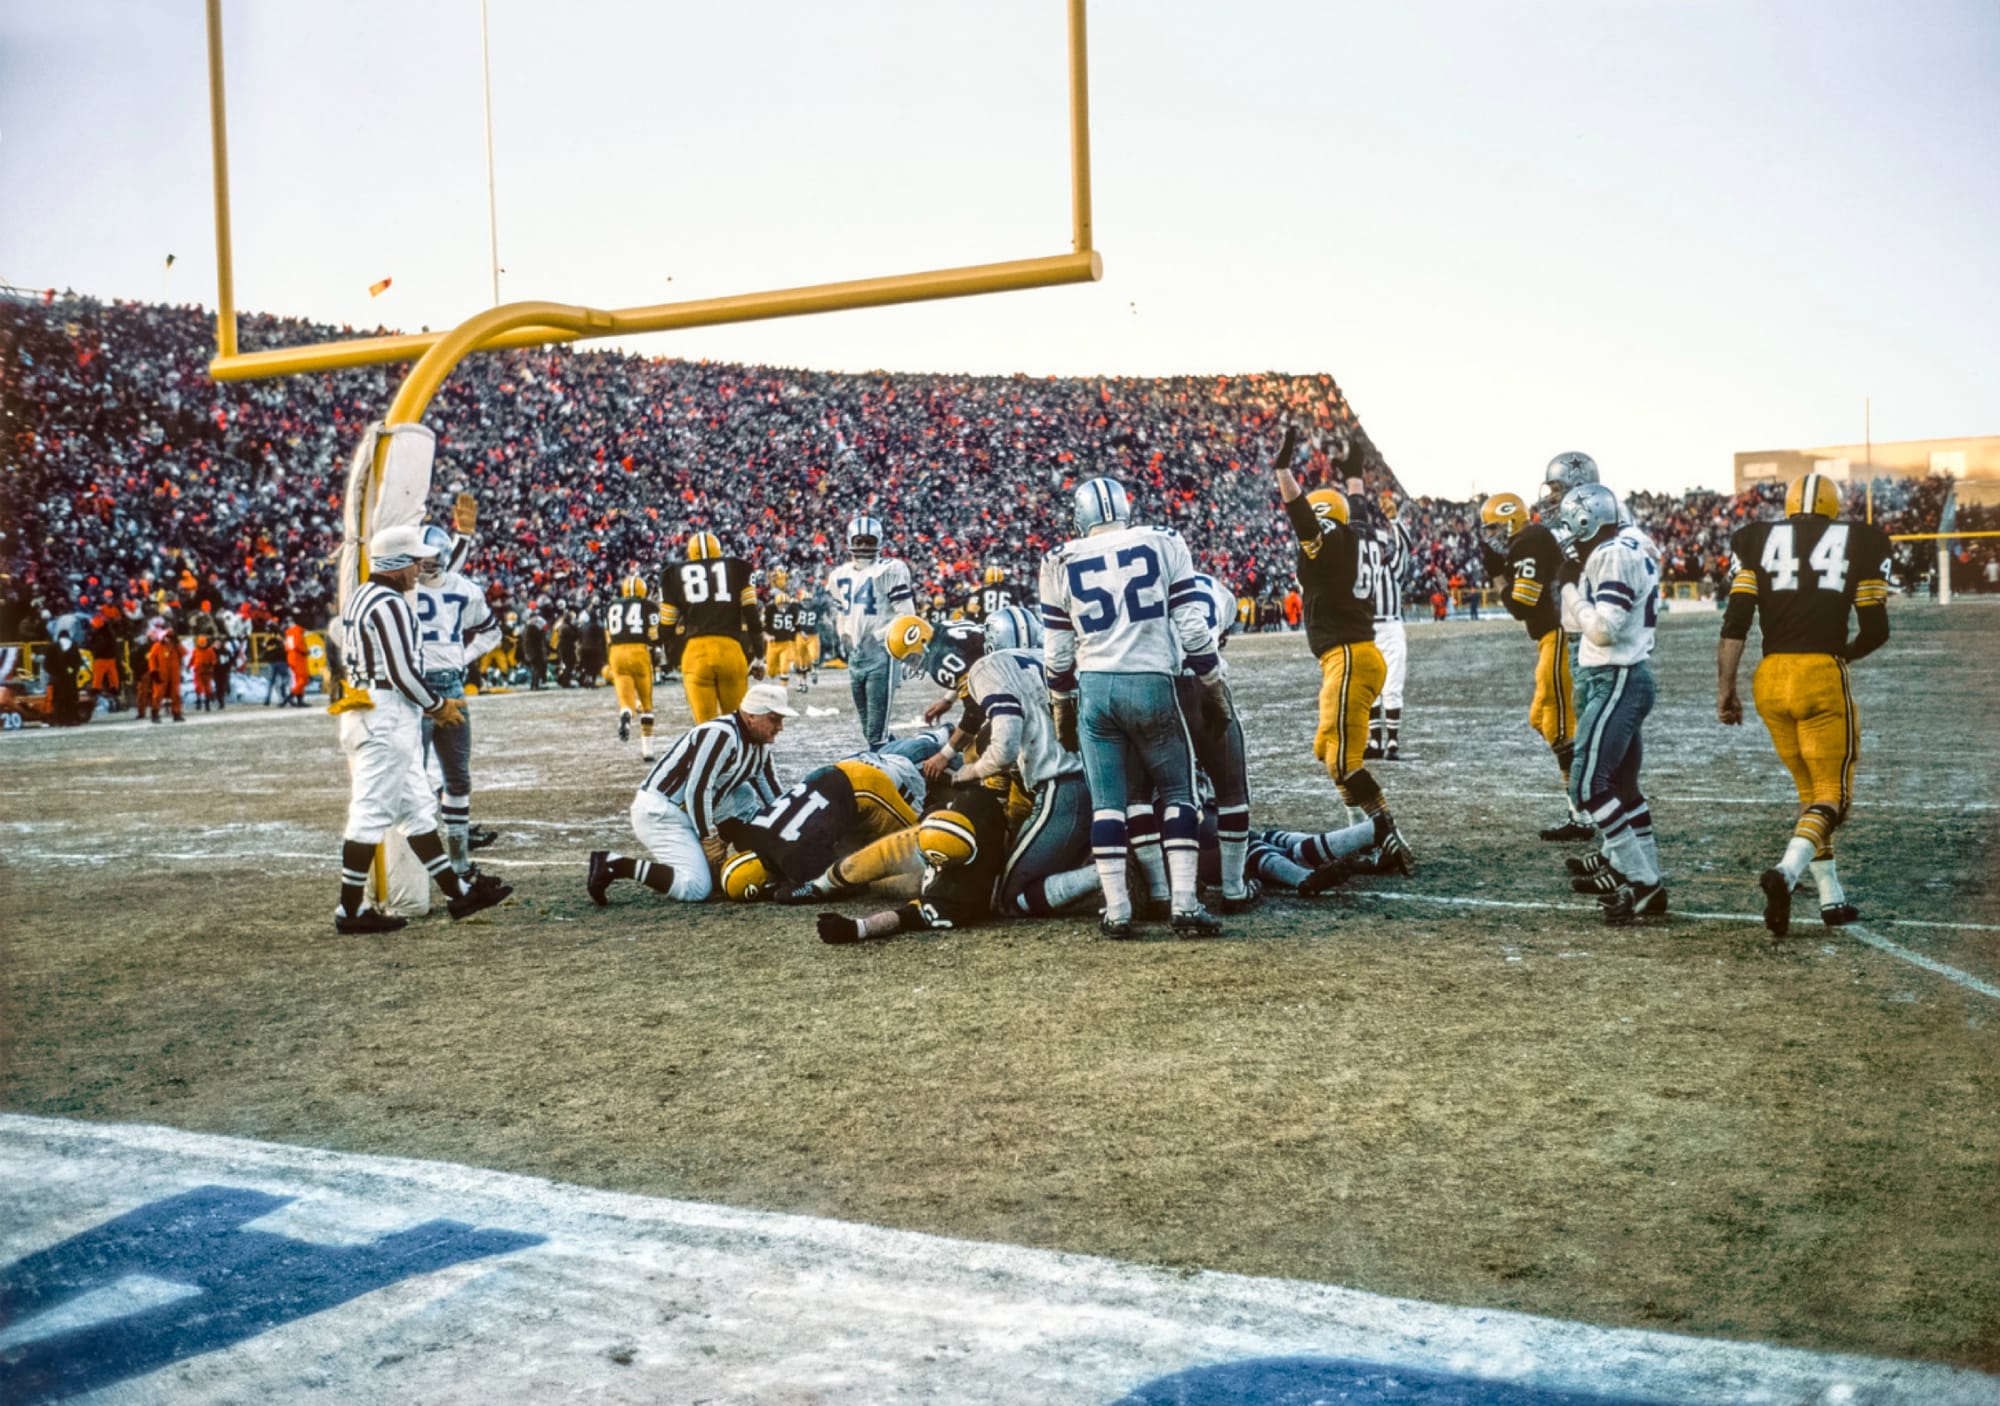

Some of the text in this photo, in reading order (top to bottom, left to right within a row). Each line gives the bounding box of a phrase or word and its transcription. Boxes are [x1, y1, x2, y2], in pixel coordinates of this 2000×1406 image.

[1495, 502, 1517, 516] G
[1513, 557, 1536, 579] 76
[1760, 524, 1849, 592] 44
[680, 562, 731, 603] 81
[837, 576, 877, 616] 34
[1067, 544, 1164, 633] 52
[417, 592, 469, 642] 27
[608, 602, 644, 635] 84
[983, 590, 1012, 613] 86
[773, 613, 794, 630] 56
[903, 624, 921, 646] G
[937, 653, 967, 688] 30
